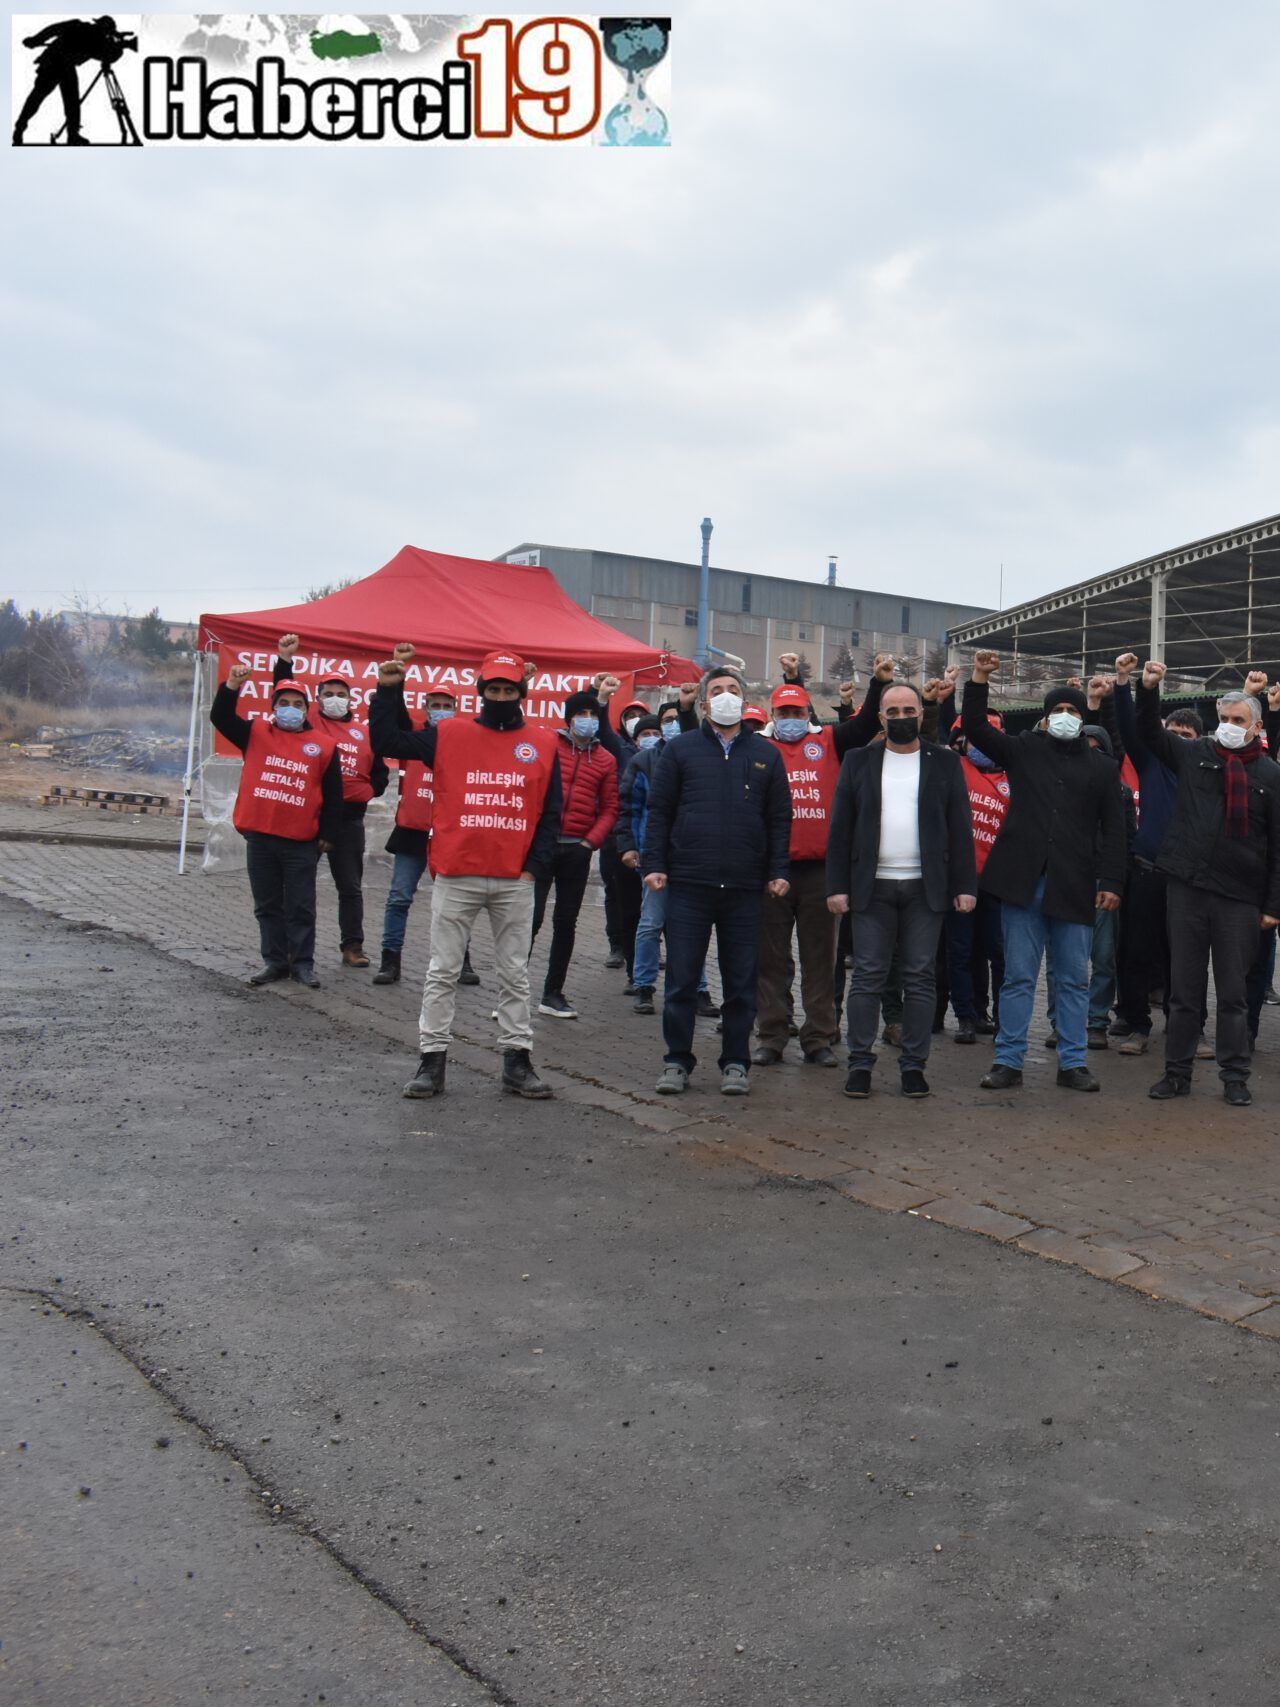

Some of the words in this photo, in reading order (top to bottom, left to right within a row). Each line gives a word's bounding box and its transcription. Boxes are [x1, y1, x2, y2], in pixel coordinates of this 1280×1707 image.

[362, 661, 478, 687] AAYAS
[265, 755, 309, 774] BİRLEŞİK
[260, 772, 306, 791] METAL-İŞ
[466, 770, 525, 788] BİRLEŞİK
[787, 769, 818, 784] LEŞİK
[253, 787, 306, 807] SENDİKASI
[464, 793, 524, 811] METAL-İŞ
[968, 790, 1006, 813] İRLEŞİK
[460, 813, 527, 831] SENDİKASI
[972, 810, 1000, 830] TAL-İŞ
